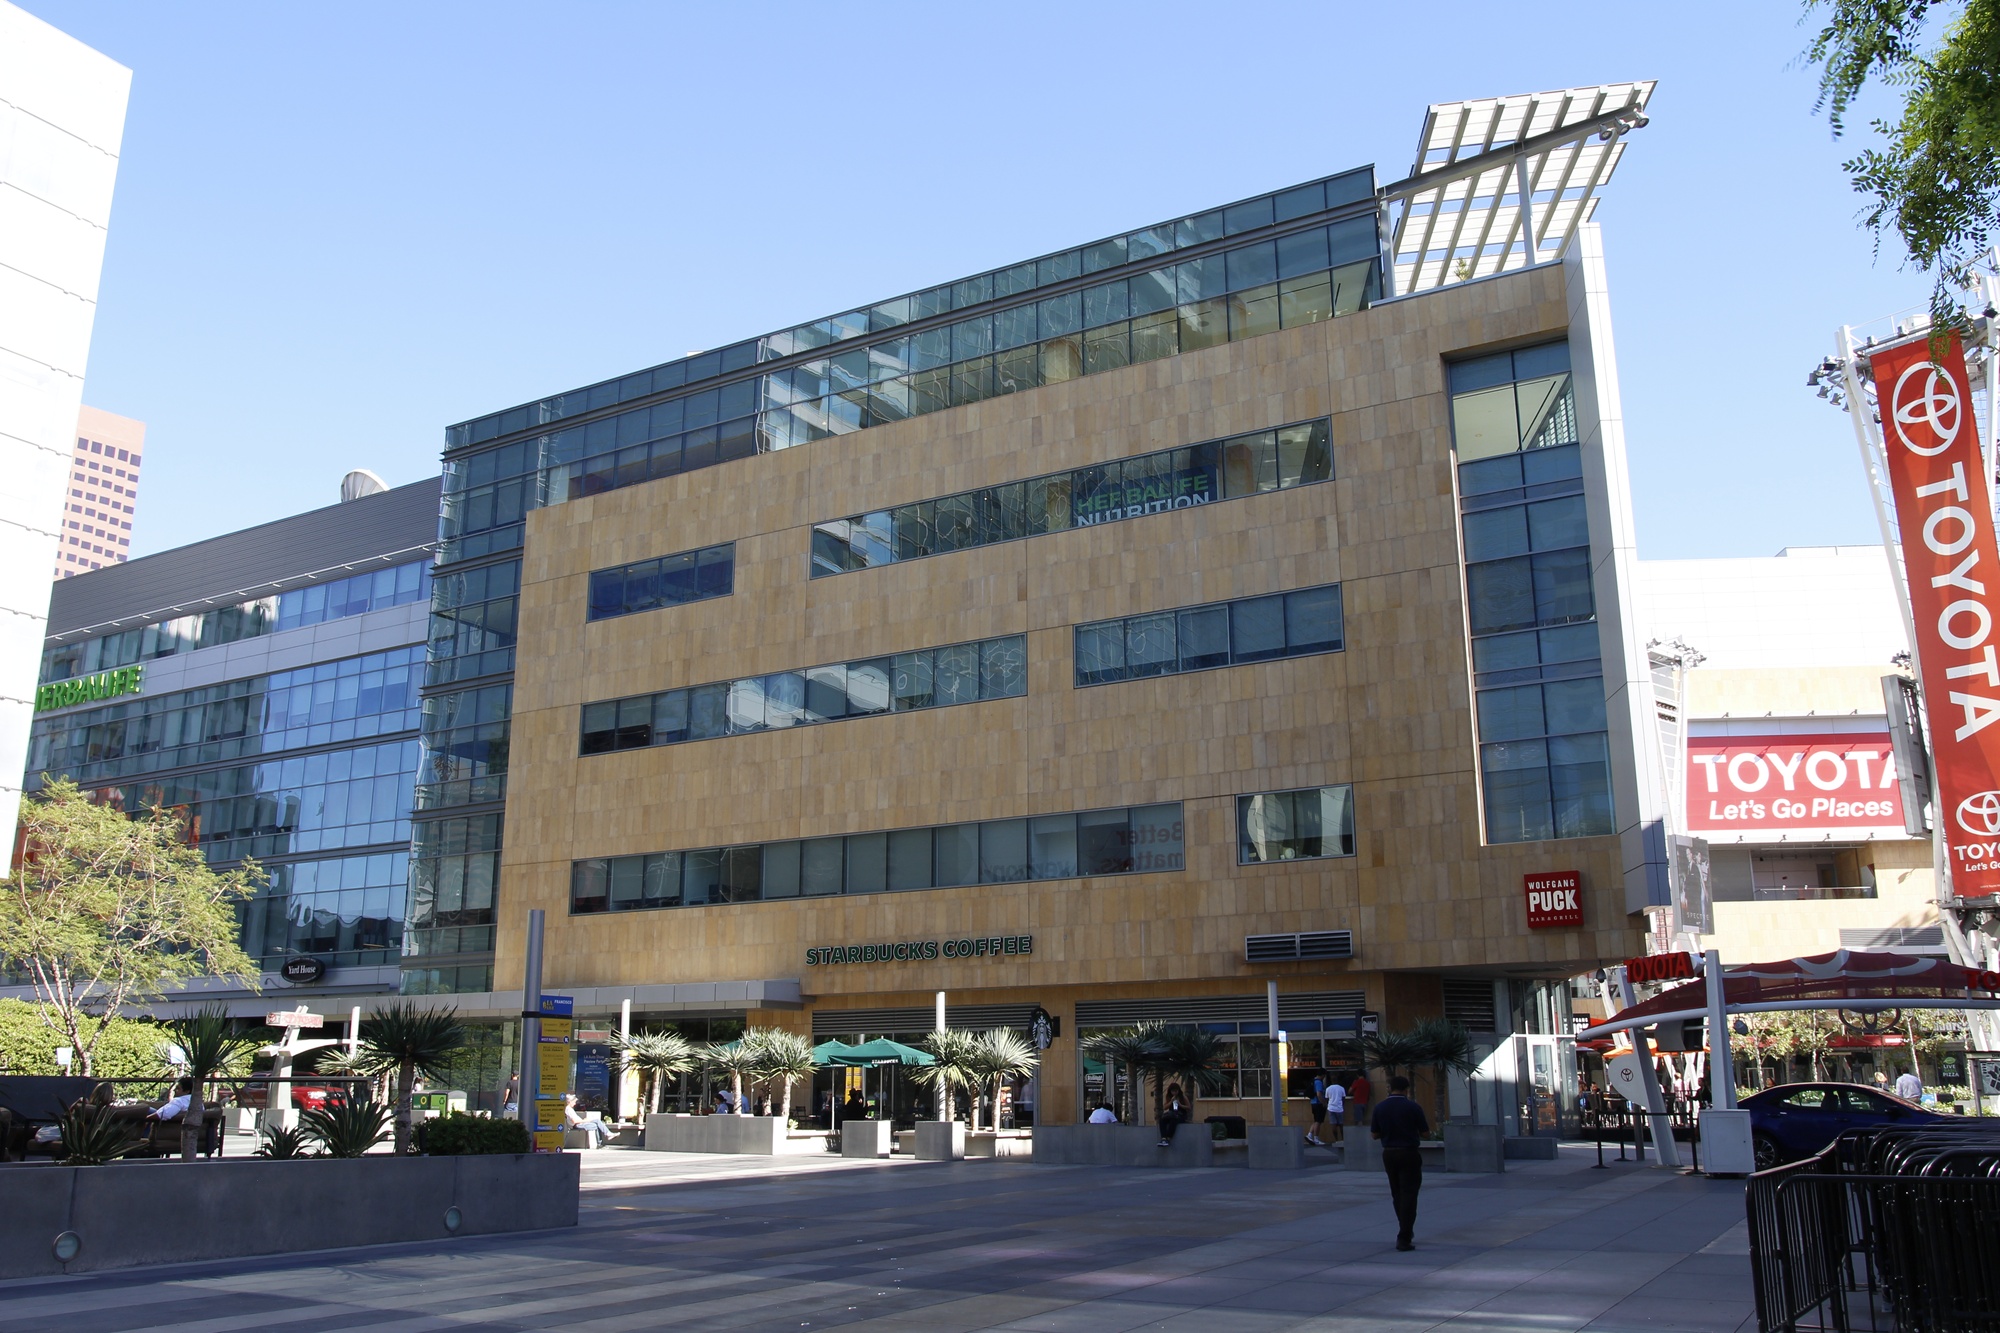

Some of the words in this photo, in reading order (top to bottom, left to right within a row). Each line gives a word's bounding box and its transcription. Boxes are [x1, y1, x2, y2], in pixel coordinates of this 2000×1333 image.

[1077, 474, 1209, 514] HERBALIFE
[1915, 461, 2000, 743] TOYOTA
[1709, 799, 1766, 821] Let's
[1771, 798, 1807, 819] Go
[1811, 797, 1894, 818] Places
[1953, 842, 2000, 861] TOY
[1989, 861, 2000, 869] G
[1528, 879, 1575, 890] WOLFGANG
[1529, 889, 1579, 912] PUCK
[1687, 911, 1710, 921] SPECTE
[805, 940, 938, 966] STARBUCKS
[942, 935, 1032, 958] COFFEE
[288, 965, 300, 975] Yard
[300, 964, 316, 974] House
[1623, 954, 1691, 983] TOYOTA
